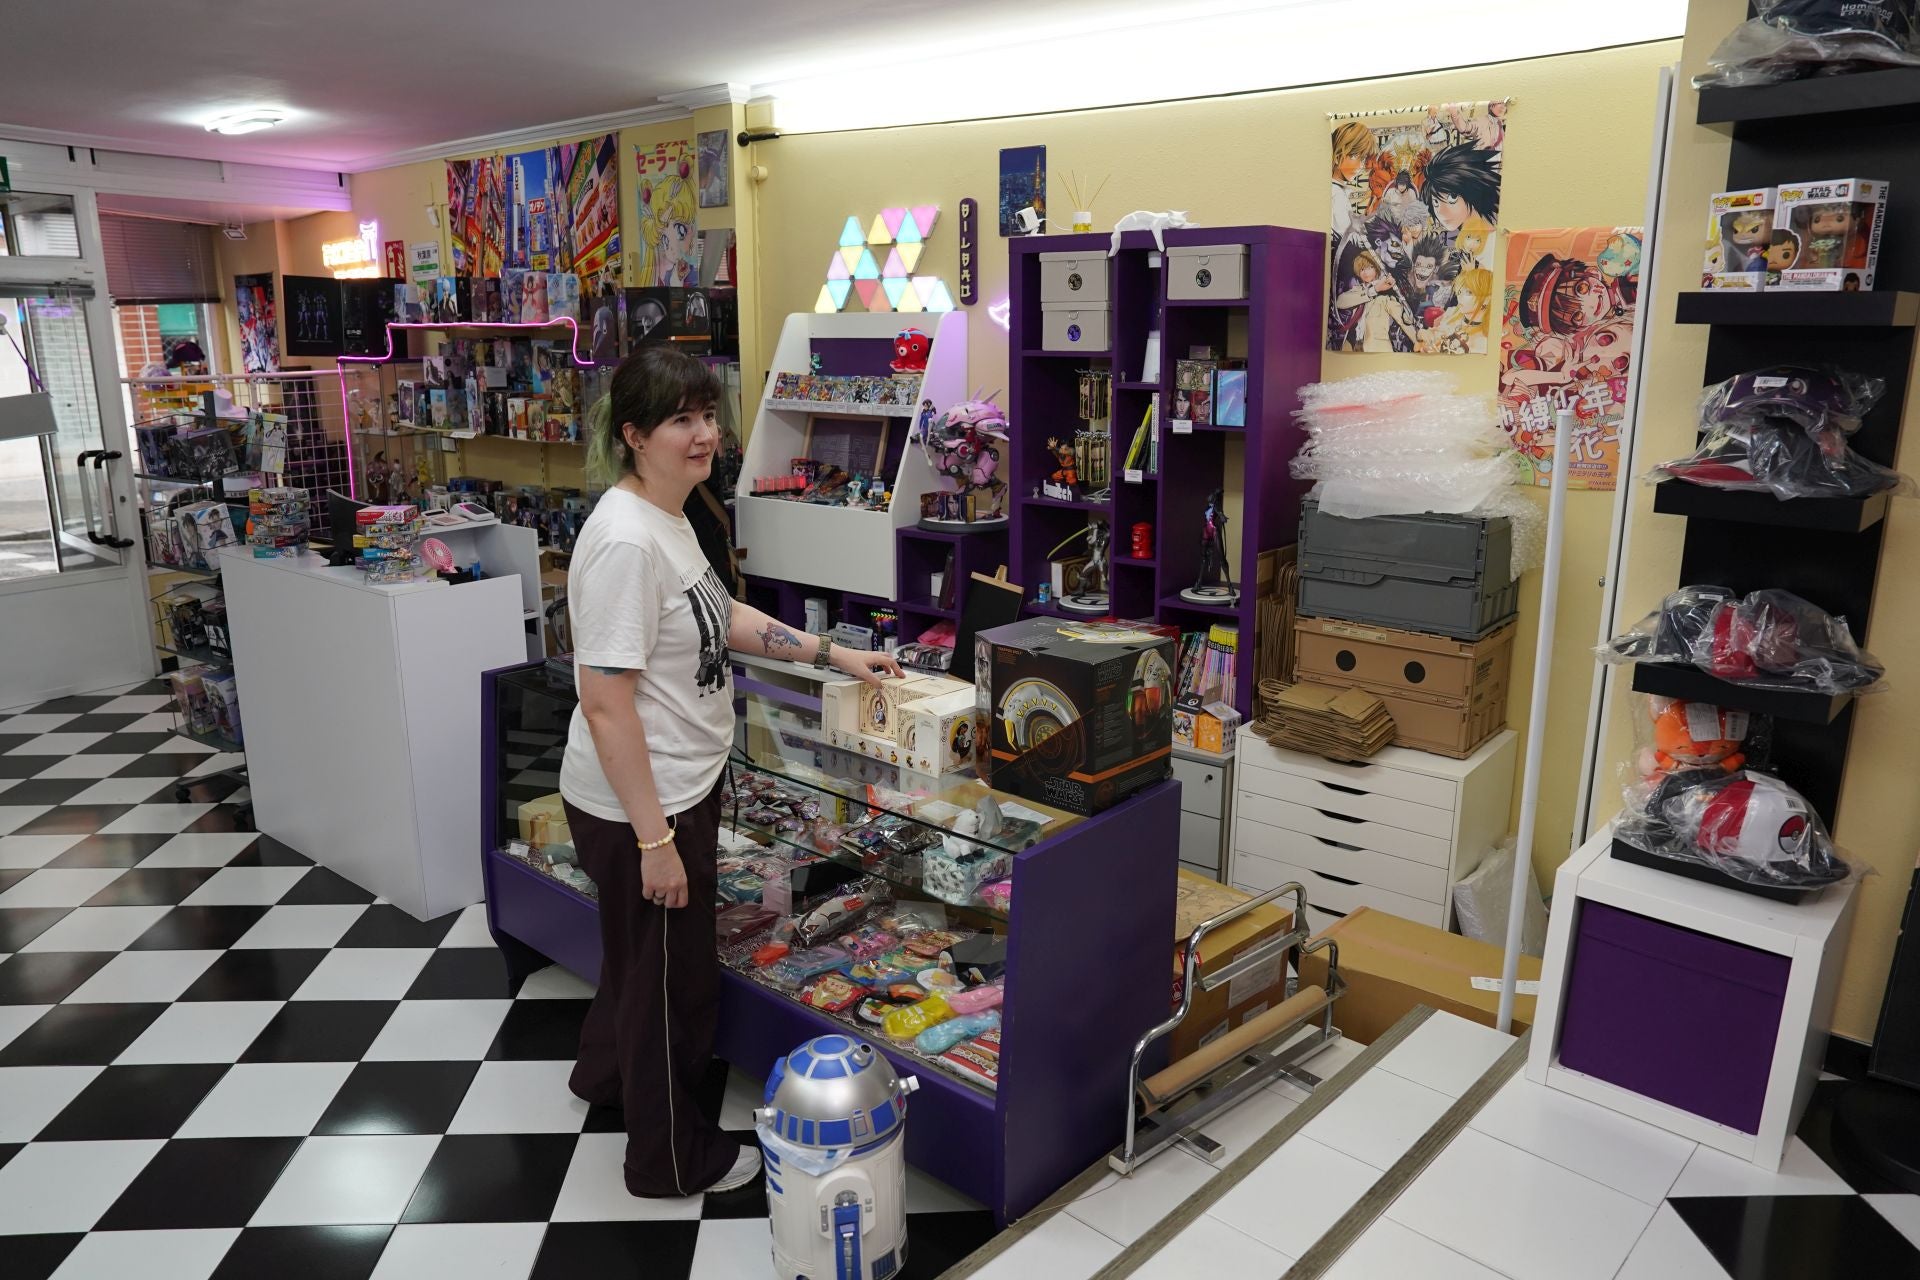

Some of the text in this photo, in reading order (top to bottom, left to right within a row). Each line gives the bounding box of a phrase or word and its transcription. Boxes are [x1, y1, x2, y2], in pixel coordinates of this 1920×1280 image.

[1807, 191, 1832, 199] WARS
[1808, 186, 1832, 194] STAR
[1879, 186, 1888, 200] THE
[1870, 202, 1886, 256] MANDALORIAN
[1043, 479, 1073, 502] twitch
[1045, 777, 1083, 793] STAR
[1046, 787, 1085, 805] WARS
